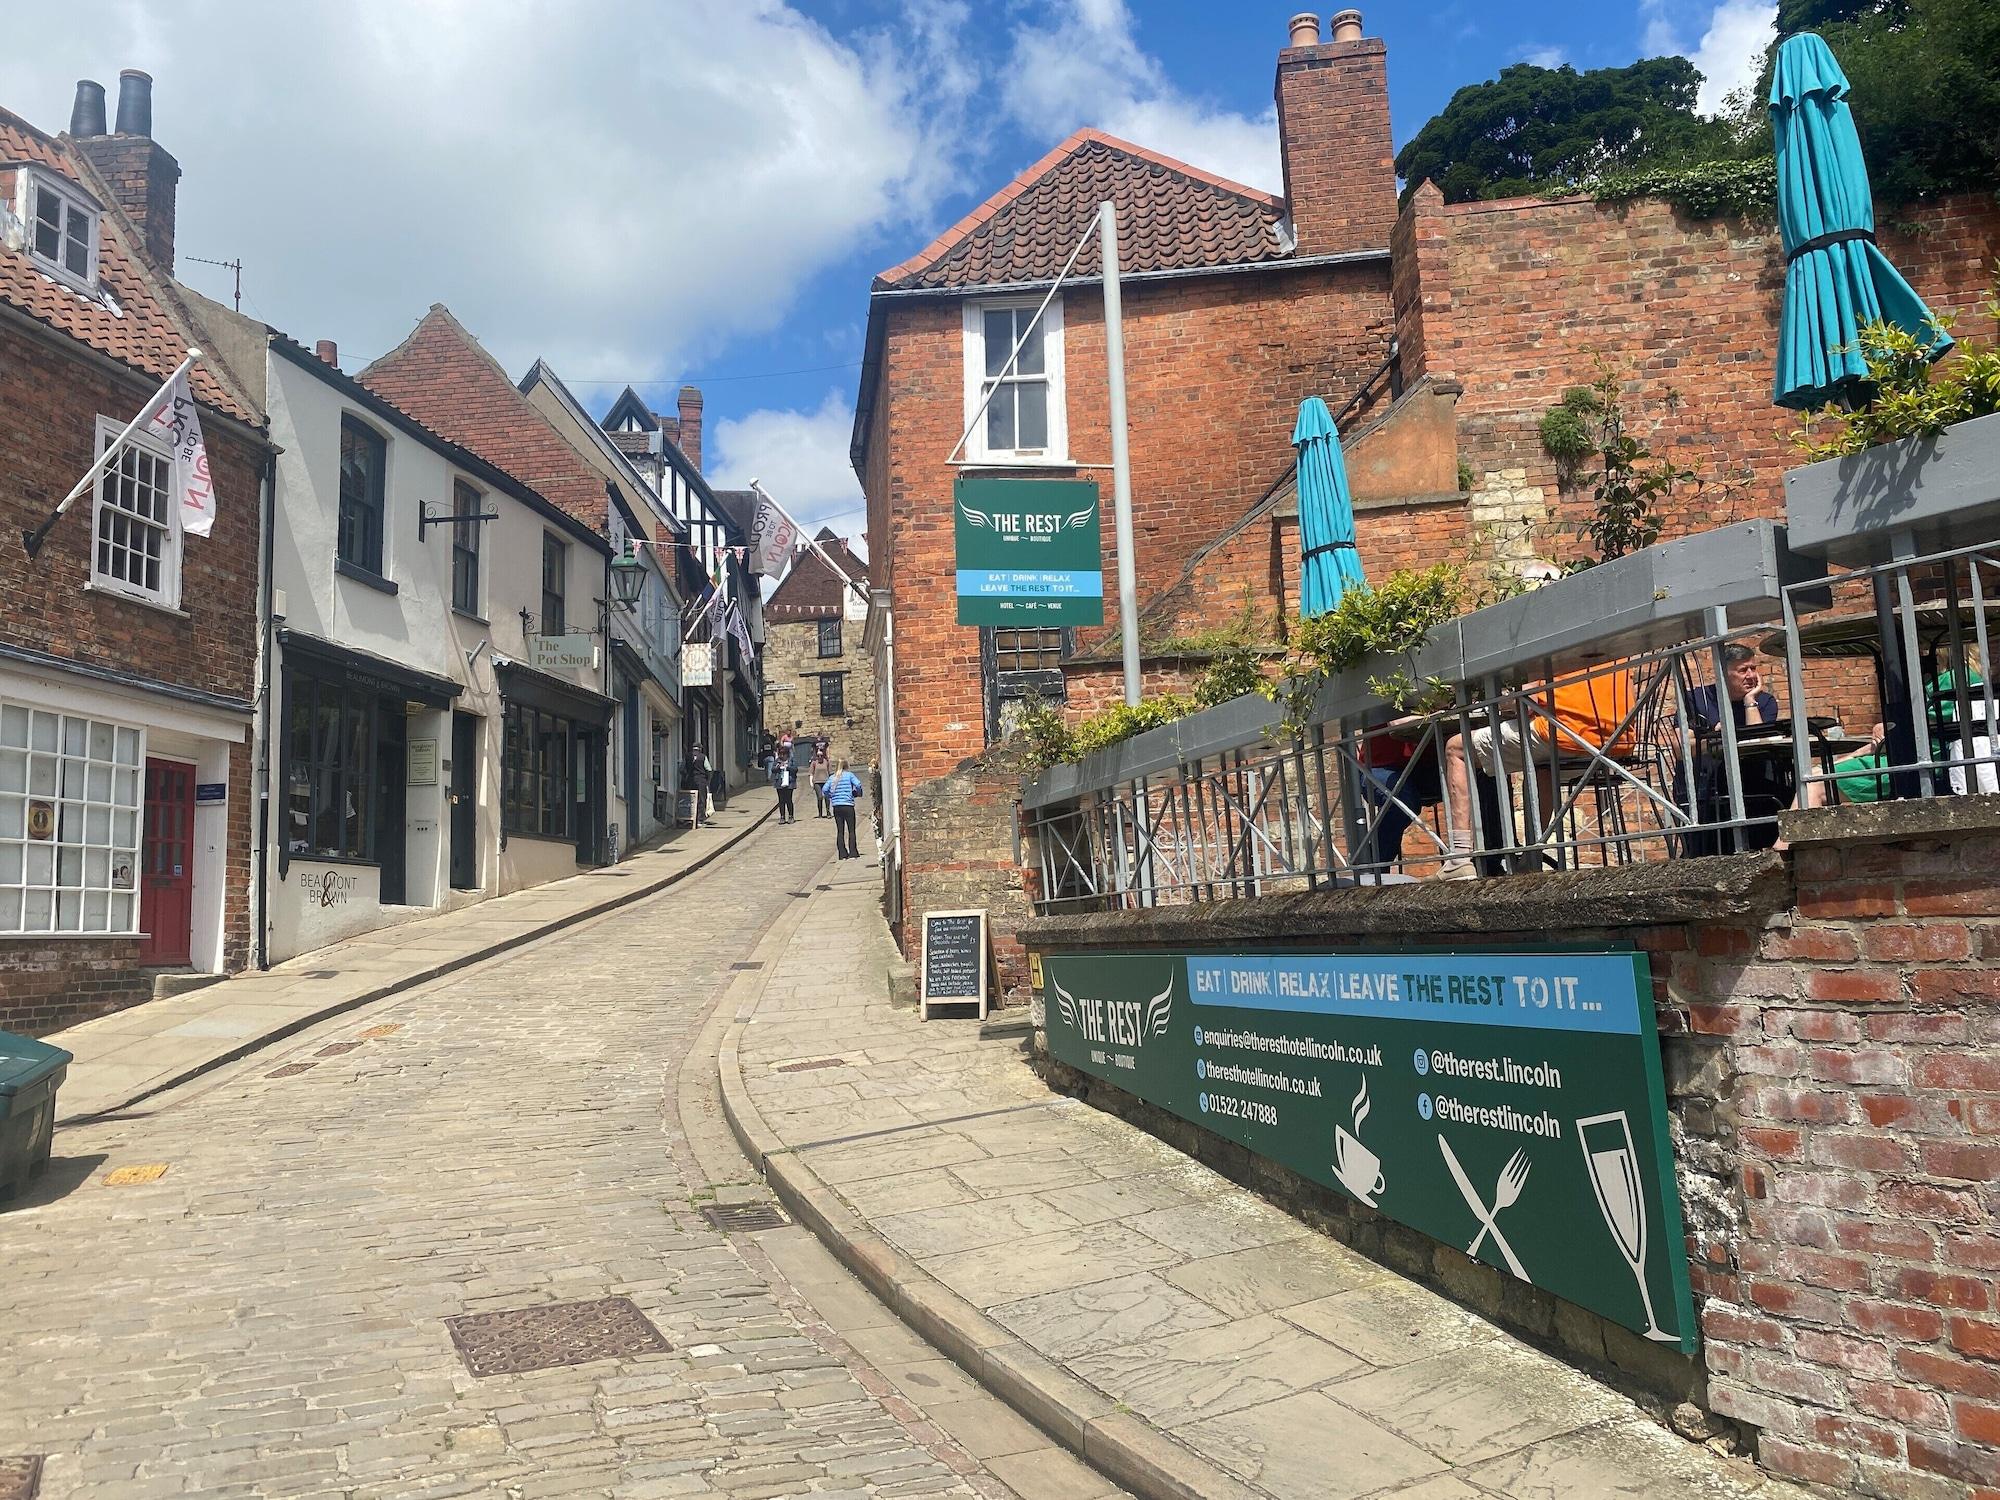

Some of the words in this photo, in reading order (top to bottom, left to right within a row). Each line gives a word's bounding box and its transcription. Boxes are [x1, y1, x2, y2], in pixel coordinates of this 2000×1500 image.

[992, 513, 1020, 532] THE
[1025, 514, 1061, 533] REST
[980, 584, 1009, 592] LEAVE
[1010, 584, 1027, 592] THE
[989, 574, 1006, 582] EAT
[538, 640, 559, 652] The
[537, 654, 557, 665] Pot
[560, 654, 591, 667] Shop
[300, 873, 358, 891] BEAUMONT
[310, 889, 347, 905] BROWN
[1196, 968, 1221, 993] EAT
[1230, 970, 1272, 996] DRINK
[1278, 972, 1332, 999] RELAX
[1339, 973, 1400, 1002] LEAVE
[1402, 974, 1444, 1004] THE
[1448, 975, 1506, 1007] REST
[1512, 976, 1549, 1009] TO
[1078, 998, 1106, 1042] THE
[1107, 1000, 1142, 1047] REST
[1204, 1027, 1383, 1067] enquiries@theresthotellincoln.co.uk
[1090, 1050, 1107, 1065] UNIQUE
[1114, 1052, 1136, 1070] BOUTIQUE
[1431, 1049, 1562, 1089] @therest.lincoln
[1206, 1060, 1322, 1097] theresthotellincoln.co.uk
[1209, 1093, 1239, 1117] 01522
[1240, 1099, 1278, 1126] 247888
[1435, 1094, 1561, 1139] @therestlincoln
